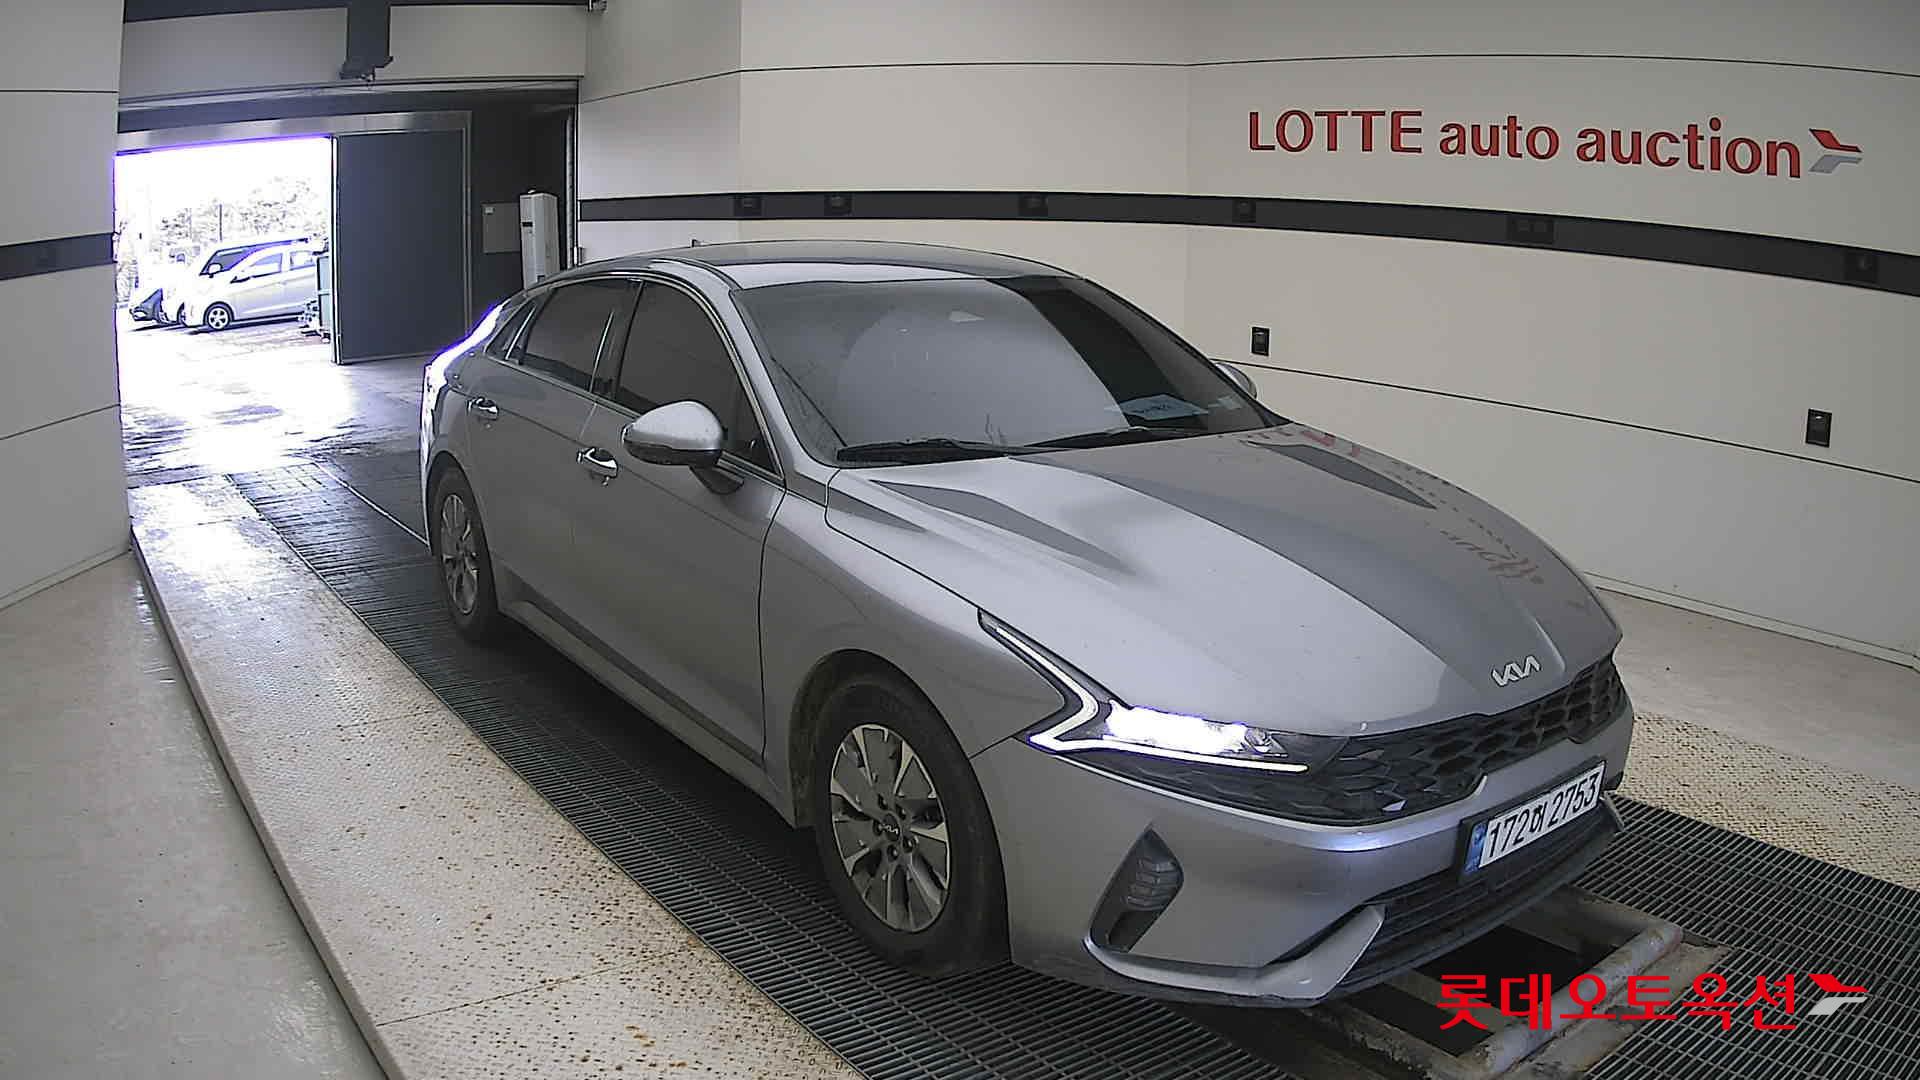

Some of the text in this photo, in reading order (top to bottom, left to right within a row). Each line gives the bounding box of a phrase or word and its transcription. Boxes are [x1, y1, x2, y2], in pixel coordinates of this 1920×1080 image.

[1248, 110, 1801, 180] LOTTE auto auction
